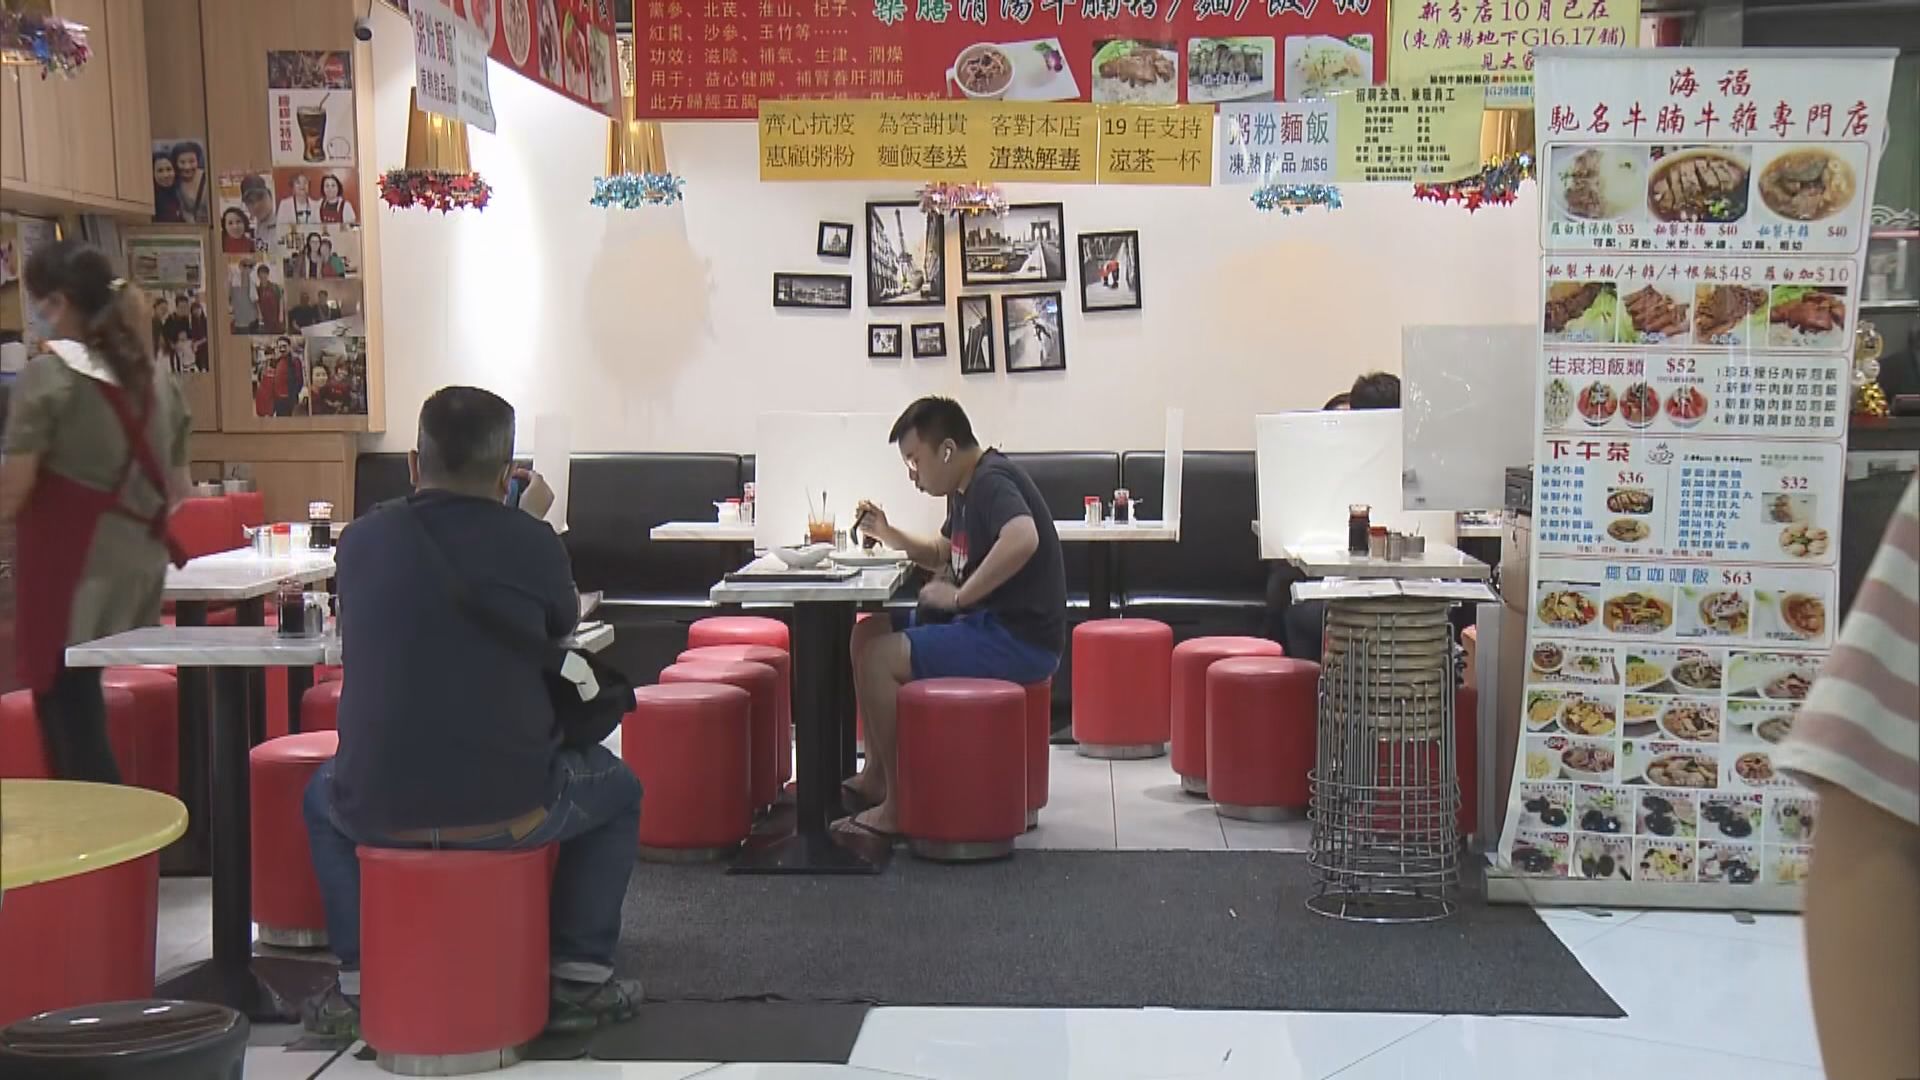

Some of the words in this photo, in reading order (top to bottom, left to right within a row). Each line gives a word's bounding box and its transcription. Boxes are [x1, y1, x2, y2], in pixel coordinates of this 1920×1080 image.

[1670, 68, 1751, 98] 海福
[765, 112, 856, 136] 齊心抗疫
[879, 112, 967, 136] 為答謝貴
[990, 115, 1082, 137] 客對本店
[1105, 118, 1126, 134] 19
[1135, 116, 1202, 139] 年支持
[1229, 111, 1329, 145] 粥粉麵飯
[1547, 101, 1869, 138] 馳名牛腩牛雜專門店
[765, 146, 855, 168] 惠顧粥粉
[878, 146, 968, 168] 麵飯奉送
[990, 148, 1081, 170] 清熱解毒
[1110, 149, 1201, 172] 涼茶一杯
[1827, 226, 1848, 237] $40
[1666, 357, 1696, 374] $52
[1546, 440, 1630, 462] 下午茶
[1618, 471, 1644, 485] $36
[1781, 477, 1808, 489] $32
[1722, 569, 1753, 585] $63
